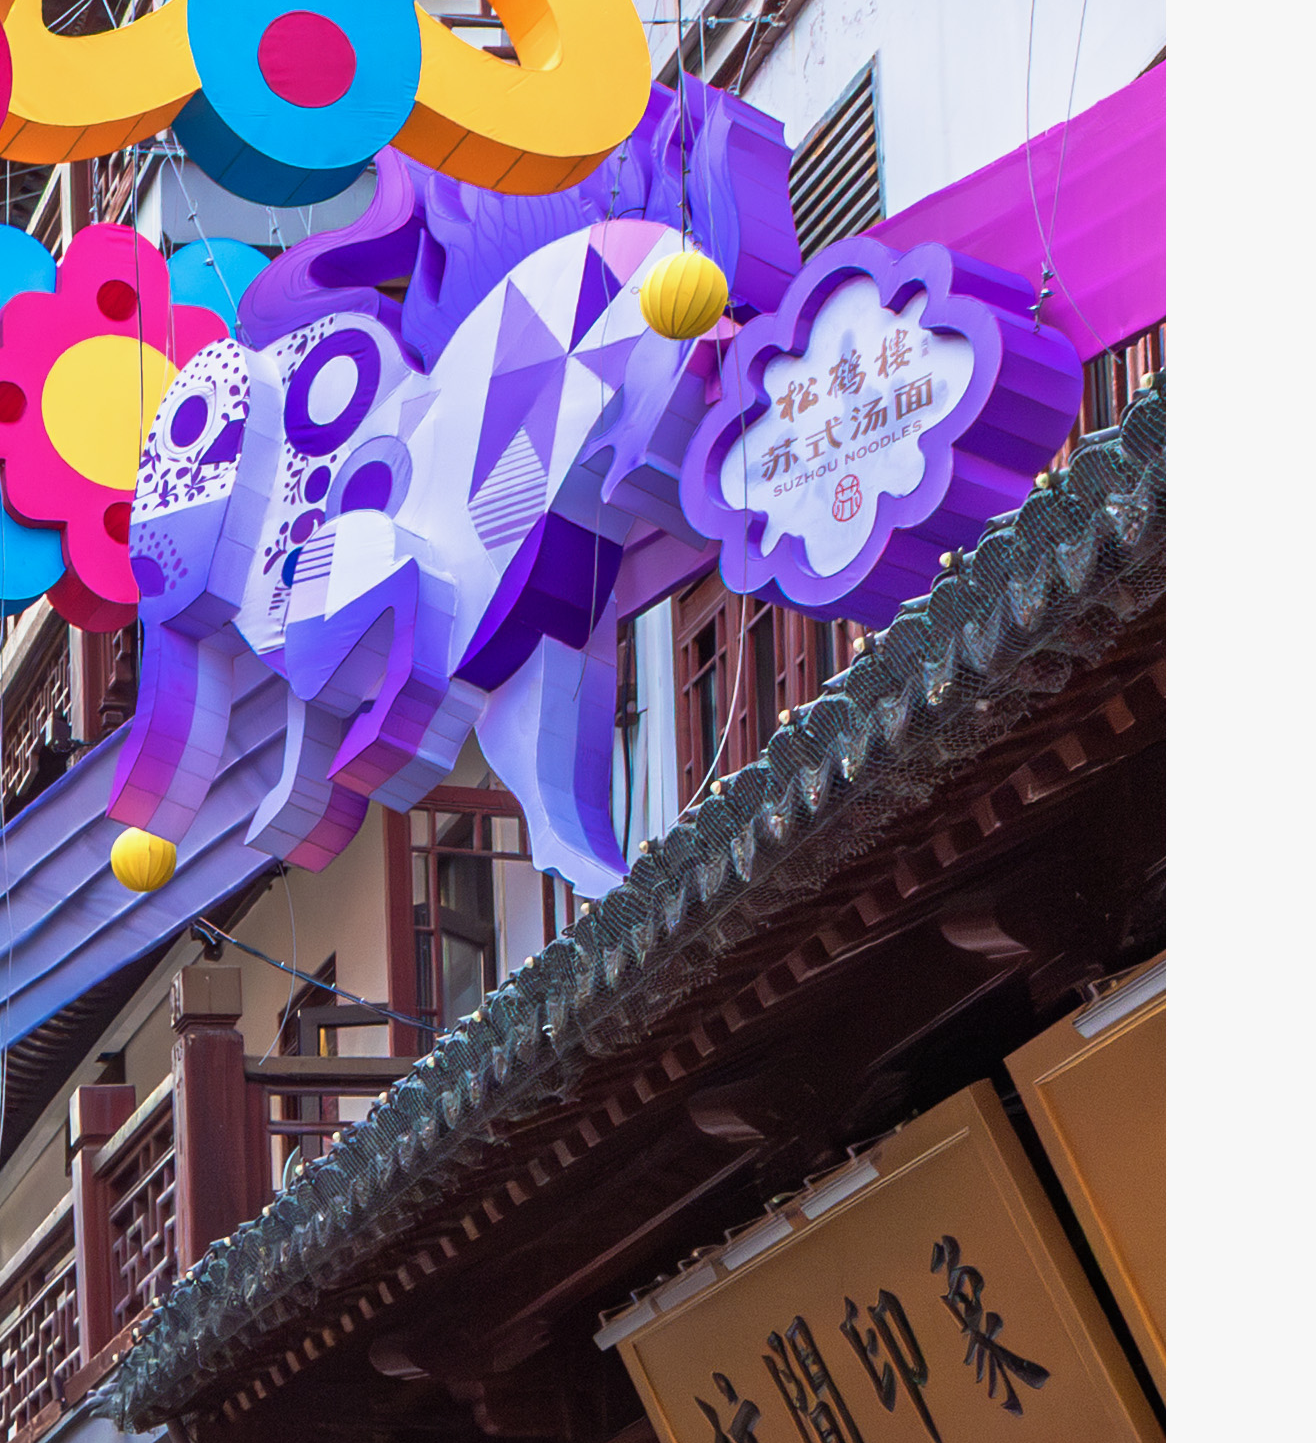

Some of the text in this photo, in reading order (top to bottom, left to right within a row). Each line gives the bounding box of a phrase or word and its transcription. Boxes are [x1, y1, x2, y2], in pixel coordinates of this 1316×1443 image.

[776, 328, 913, 423] 松鶴樓
[761, 371, 934, 482] 苏式汤面
[773, 419, 924, 497] SUZHOU NOODLES
